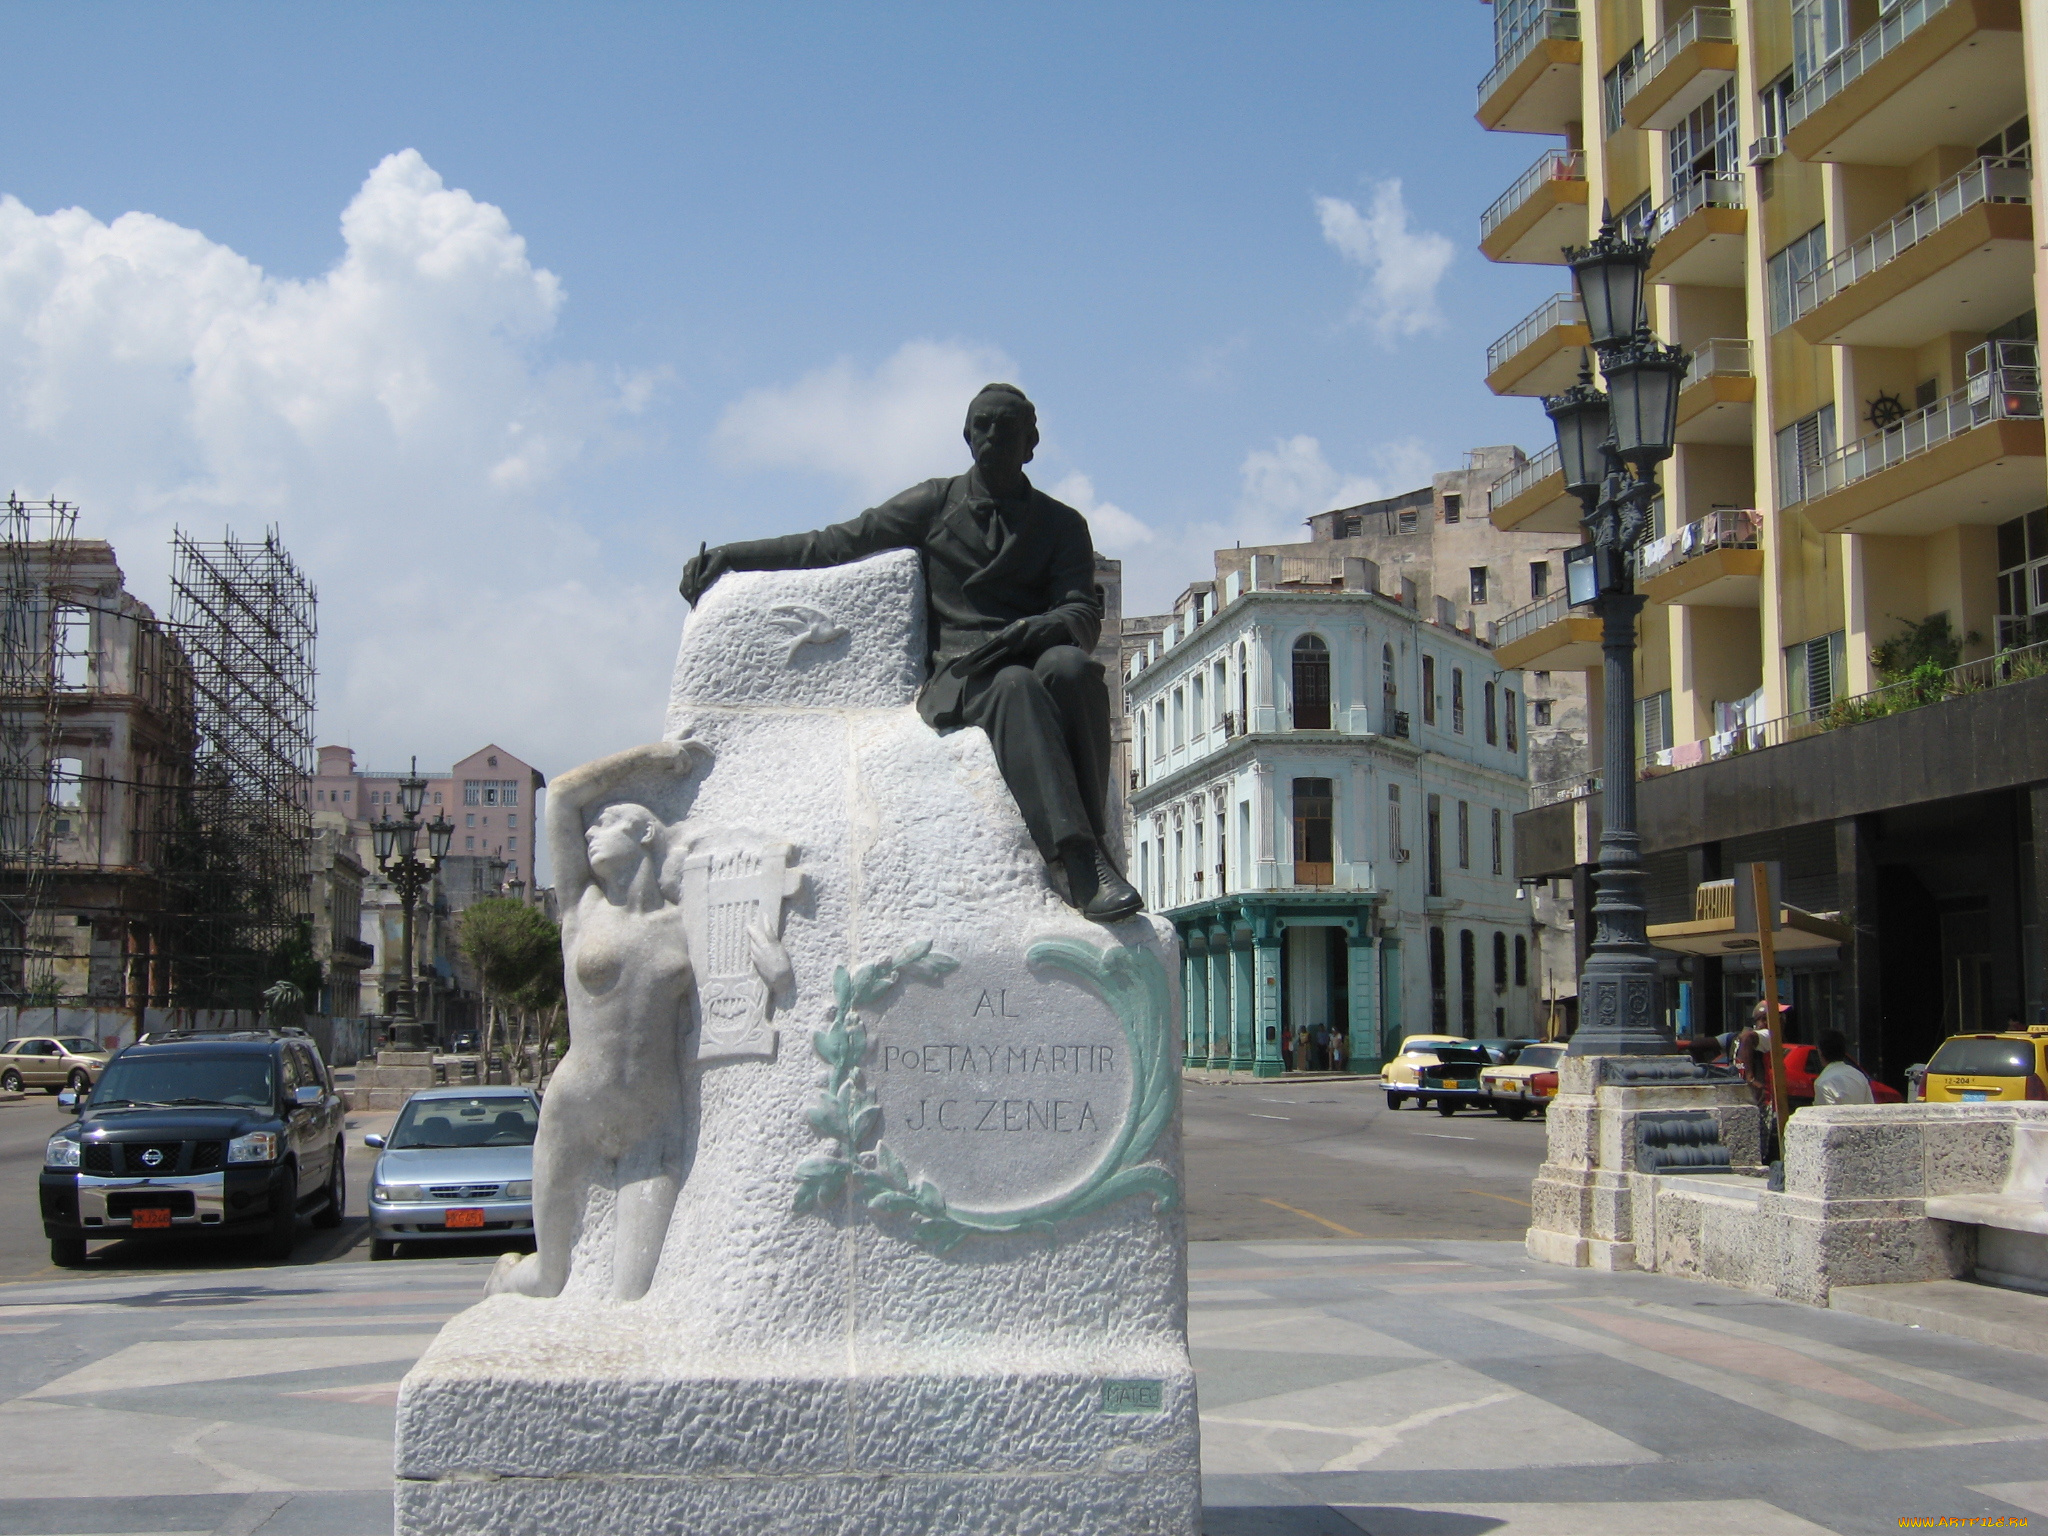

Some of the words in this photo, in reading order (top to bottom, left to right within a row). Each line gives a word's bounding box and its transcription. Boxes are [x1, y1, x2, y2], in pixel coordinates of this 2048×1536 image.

[973, 988, 1020, 1018] AL
[1007, 1045, 1114, 1074] MARTIR
[975, 1100, 1098, 1132] ZENEA
